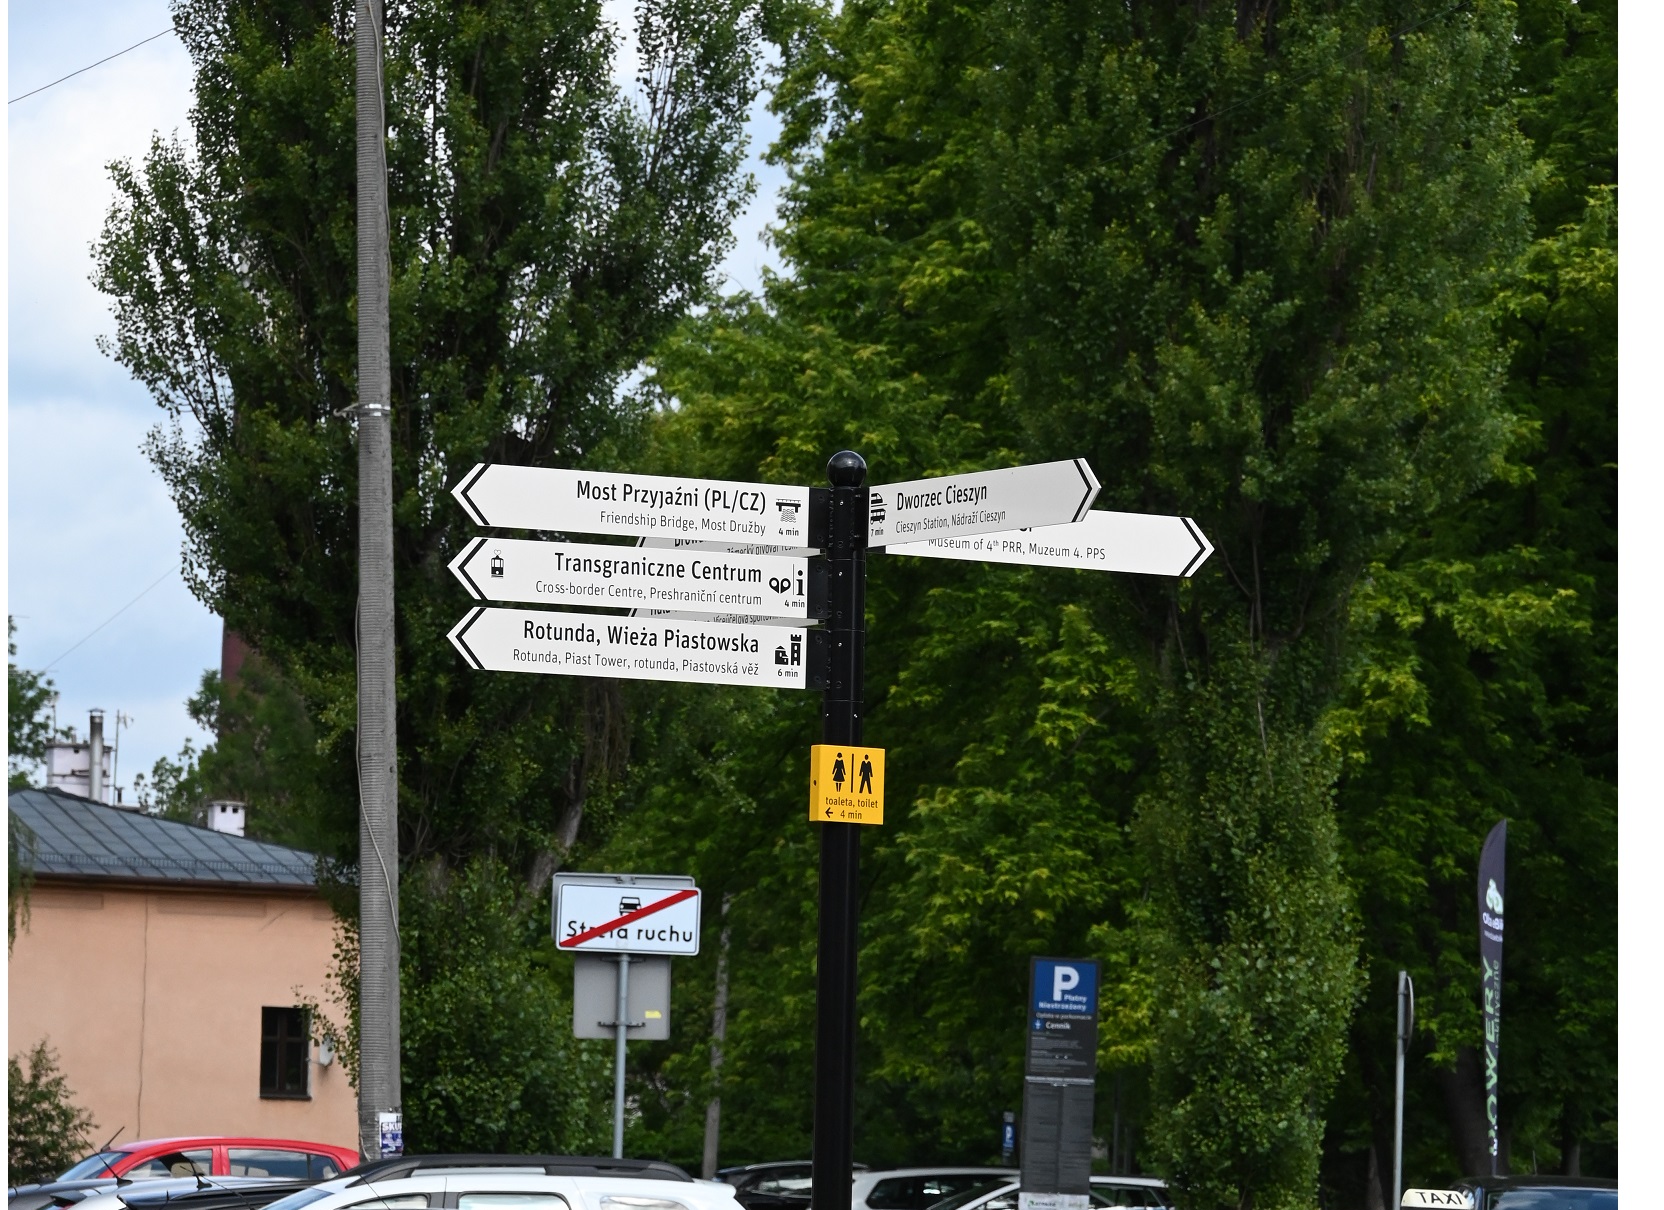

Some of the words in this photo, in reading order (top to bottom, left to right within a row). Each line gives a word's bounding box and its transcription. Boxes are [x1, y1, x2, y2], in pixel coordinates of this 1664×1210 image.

[576, 480, 617, 502] Most
[623, 483, 699, 510] Przyjaźni
[704, 486, 766, 515] (PL/CZ)
[897, 491, 942, 511] Dworzec
[945, 484, 988, 505] Cieszyn
[600, 510, 657, 528] Friendship
[660, 513, 698, 531] Bridge,
[701, 518, 727, 532] Most
[729, 519, 766, 536] Družby
[778, 527, 784, 535] 4
[786, 527, 800, 537] min
[875, 527, 884, 536] min
[895, 518, 922, 535] Cieszyn
[923, 515, 950, 531] Station,
[951, 511, 978, 527] Nádraží
[979, 509, 1006, 525] Cieszyn
[928, 538, 971, 551] Museum
[973, 538, 984, 551] of
[1002, 541, 1026, 555] PRR,
[1029, 543, 1071, 558] Muzeum
[1073, 547, 1084, 558] 4.
[1086, 547, 1107, 561] PPS
[554, 551, 686, 579] Transgraniczne
[691, 560, 763, 584] Centrum
[535, 580, 605, 597] Cross-border
[608, 583, 647, 600] Centre,
[650, 586, 716, 603] Preshraniční
[719, 591, 762, 606] centrum
[784, 599, 791, 608] 4
[792, 599, 806, 609] min
[523, 620, 601, 646] Rotunda,
[607, 625, 658, 648] Wieża
[664, 628, 759, 653] Piastowska
[513, 648, 561, 665] Rotunda,
[565, 651, 591, 666] Piast
[595, 653, 630, 669] Tower,
[634, 656, 679, 672] rotunda,
[682, 659, 738, 675] Piastovská
[741, 663, 759, 676] věž
[777, 668, 783, 677] 6
[784, 669, 799, 678] min
[825, 796, 855, 808] toaleta,
[857, 798, 879, 809] toilet
[840, 810, 845, 818] 4
[848, 810, 862, 820] min
[566, 920, 628, 940] Sta
[637, 925, 693, 943] ruchu
[1053, 965, 1080, 1001] P
[1415, 1191, 1463, 1205] TAXI
